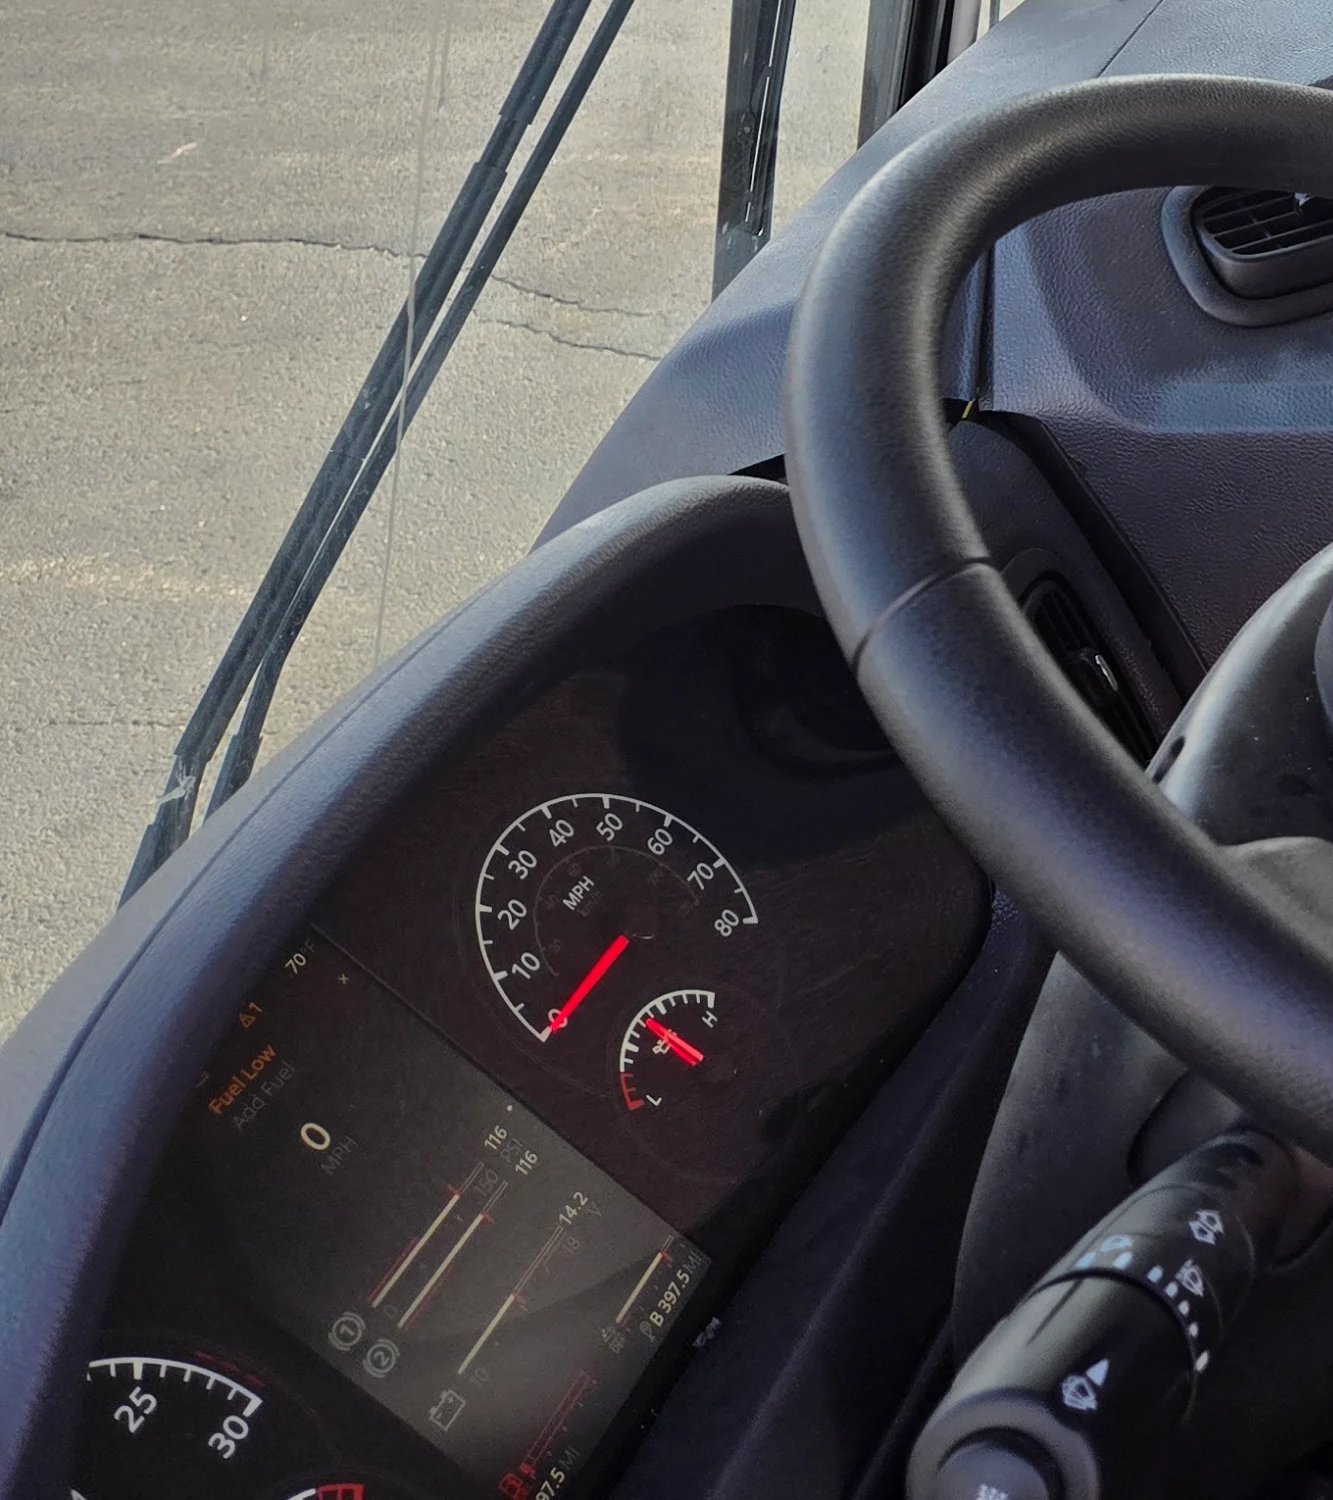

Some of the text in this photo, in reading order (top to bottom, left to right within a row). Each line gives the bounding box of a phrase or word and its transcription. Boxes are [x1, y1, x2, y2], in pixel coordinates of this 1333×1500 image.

[548, 819, 575, 848] 40
[596, 812, 624, 842] 50
[647, 828, 674, 856] 60
[508, 849, 538, 880] 30
[687, 862, 715, 890] 70
[562, 875, 596, 911] MPH
[497, 898, 528, 930] 20
[713, 908, 740, 937] 80
[511, 952, 541, 980] 10
[249, 1002, 263, 1014] 1
[701, 1011, 719, 1029] H
[208, 1044, 278, 1115] Fuel Low
[231, 1058, 298, 1131] Add Fuel
[645, 1094, 663, 1107] L
[300, 1121, 331, 1151] 0
[484, 1124, 508, 1151] 116
[320, 1134, 360, 1177] MPH
[515, 1150, 539, 1176] 116
[473, 1170, 499, 1198] 150
[558, 1191, 589, 1226] 14.2
[656, 1269, 691, 1314] 397.5
[649, 1309, 665, 1328] B
[113, 1386, 159, 1434] 25
[207, 1414, 250, 1460] 30
